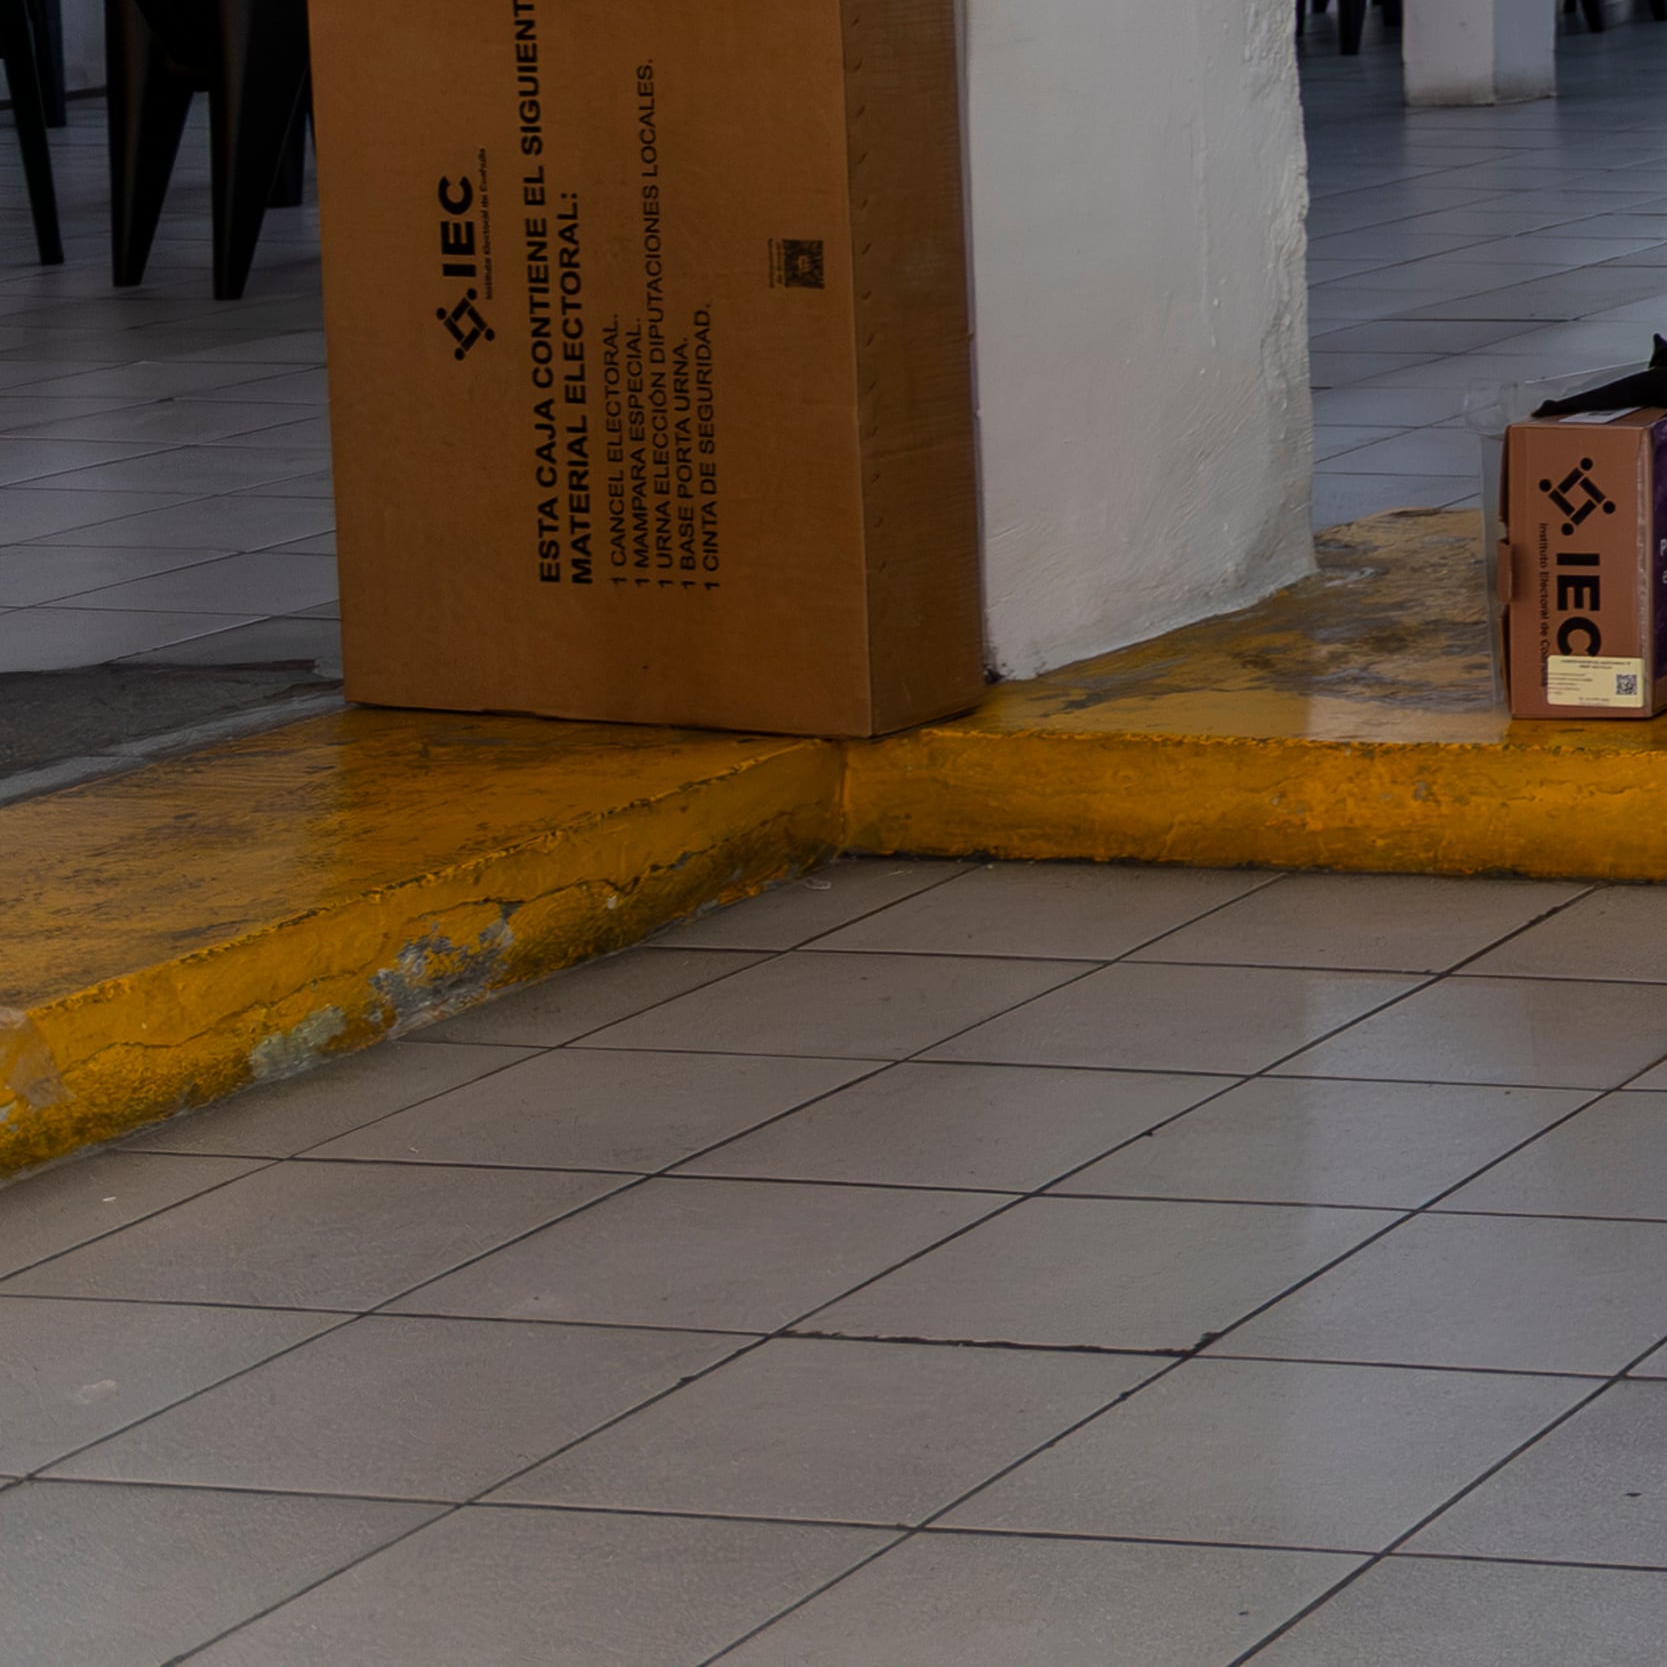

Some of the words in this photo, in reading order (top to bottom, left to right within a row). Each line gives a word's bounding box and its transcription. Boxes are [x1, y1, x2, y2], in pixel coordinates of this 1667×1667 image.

[636, 58, 659, 177] LOCALES.
[438, 175, 478, 278] IEC
[523, 165, 546, 207] EL
[525, 217, 555, 389] CONTIENE
[557, 192, 589, 405] ELECTORAL:
[642, 184, 666, 368] DIPUTACIONES
[602, 313, 624, 463] ELECTORAL.
[626, 318, 646, 445] ESPECIAL.
[672, 337, 691, 414] URNA.
[693, 303, 716, 456] SEGURIDAD.
[532, 397, 558, 489] CAJA
[648, 372, 672, 496] ELECCIÓN
[675, 417, 694, 499] PORTA
[565, 414, 593, 585] MATERIAL
[607, 469, 628, 568] CANCEL
[629, 447, 650, 569] MAMPARA
[700, 461, 717, 496] DE
[537, 496, 561, 584] ESTA
[654, 500, 674, 569] URNA
[678, 503, 697, 572] BASE
[702, 499, 720, 573] CINTA
[1539, 522, 1549, 568] Instituto
[611, 575, 628, 586] 1
[636, 577, 650, 587] 1
[657, 578, 674, 589] 1
[680, 579, 697, 590] 1
[704, 581, 720, 591] 1
[1539, 571, 1549, 619] Electoral
[1556, 552, 1602, 656] IEC
[1540, 622, 1550, 636] de
